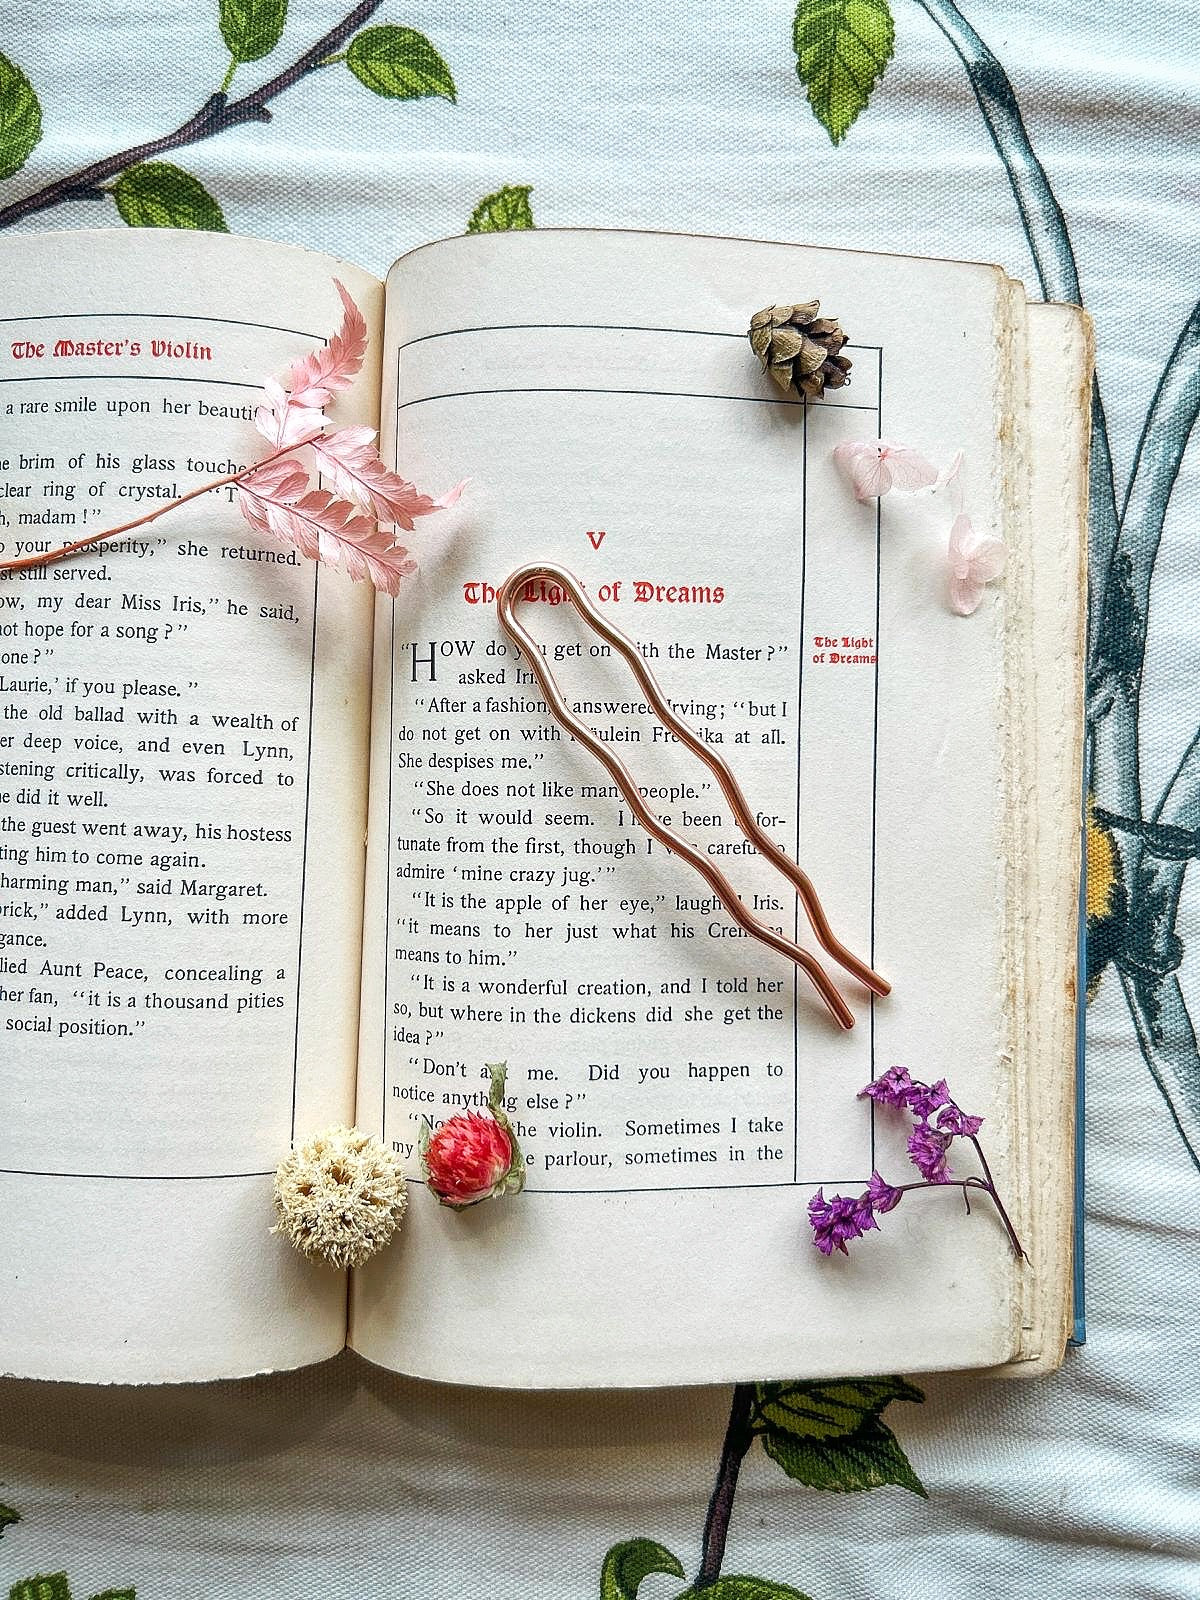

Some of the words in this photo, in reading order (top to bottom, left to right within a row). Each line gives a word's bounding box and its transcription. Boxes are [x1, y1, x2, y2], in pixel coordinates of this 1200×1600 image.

[11, 342, 45, 359] The
[151, 340, 212, 360] Violin
[20, 402, 48, 414] rare
[55, 397, 97, 413] smile
[107, 401, 150, 416] upon
[163, 398, 191, 414] her
[20, 454, 55, 469] brim
[68, 453, 86, 469] of
[96, 453, 120, 468] his
[132, 454, 175, 473] glass
[44, 481, 76, 501] ring
[89, 481, 106, 496] of
[119, 483, 181, 501] crystal.
[586, 532, 606, 550] V
[15, 541, 51, 557] your
[178, 541, 208, 557] she
[221, 545, 301, 566] returned.
[54, 565, 111, 580] served.
[598, 581, 622, 602] of
[633, 582, 724, 603] Dreams
[37, 596, 63, 613] my
[75, 593, 111, 608] dear
[121, 594, 161, 611] Miss
[227, 599, 248, 615] he
[260, 604, 299, 623] said,
[25, 621, 64, 641] hope
[70, 621, 94, 637] for
[486, 640, 507, 656] do
[554, 643, 582, 661] get
[590, 646, 611, 657] on
[668, 643, 695, 659] the
[813, 637, 838, 647] The
[841, 637, 873, 649] Light
[813, 653, 825, 663] of
[828, 653, 878, 664] Dreams
[459, 669, 506, 684] asked
[66, 677, 78, 693] if
[82, 682, 115, 697] you
[121, 679, 180, 699] please.
[4, 704, 27, 719] the
[39, 705, 62, 720] old
[75, 706, 124, 722] ballad
[137, 709, 178, 724] with
[212, 713, 273, 729] wealth
[281, 717, 299, 731] of
[399, 726, 414, 741] do
[423, 727, 447, 740] not
[455, 727, 481, 745] get
[489, 729, 510, 741] on
[520, 725, 560, 741] with
[735, 731, 750, 743] at
[761, 729, 785, 744] all.
[23, 733, 61, 753] deep
[74, 734, 122, 753] voice,
[138, 737, 170, 752] and
[182, 743, 225, 755] even
[243, 741, 293, 761] Lynn,
[399, 753, 422, 768] She
[429, 753, 494, 772] despises
[66, 762, 144, 784] critically,
[159, 770, 195, 782] was
[207, 768, 263, 784] forced
[277, 773, 294, 786] to
[17, 788, 41, 804] did
[48, 789, 59, 805] it
[67, 791, 108, 807] well.
[462, 781, 499, 796] does
[507, 783, 535, 797] not
[543, 781, 573, 797] like
[456, 809, 467, 824] it
[478, 809, 532, 825] would
[545, 814, 594, 825] seem.
[682, 811, 721, 826] been
[1, 816, 25, 831] the
[32, 820, 76, 837] guest
[82, 822, 127, 836] went
[134, 826, 187, 843] away,
[196, 823, 221, 839] his
[227, 824, 291, 842] hostess
[398, 836, 440, 851] tunate
[446, 837, 484, 852] from
[491, 837, 518, 853] the
[525, 837, 564, 856] first,
[572, 838, 635, 859] though
[36, 846, 66, 862] him
[72, 850, 89, 863] to
[97, 853, 143, 865] come
[150, 852, 205, 871] again.
[397, 863, 444, 879] admire
[510, 870, 555, 886] crazy
[137, 879, 172, 895] said
[180, 880, 267, 901] Margaret.
[442, 892, 454, 908] is
[460, 893, 486, 909] the
[496, 895, 541, 914] apple
[552, 895, 570, 910] of
[580, 895, 608, 911] her
[753, 895, 783, 910] Iris.
[56, 904, 108, 921] added
[121, 906, 172, 927] Lynn,
[187, 909, 229, 924] with
[243, 913, 288, 925] more
[430, 924, 480, 937] means
[494, 924, 511, 938] to
[525, 923, 553, 938] her
[565, 923, 598, 943] just
[612, 923, 657, 939] what
[671, 923, 694, 938] his
[396, 949, 439, 963] means
[445, 950, 461, 964] to
[40, 960, 82, 977] Aunt
[94, 962, 148, 982] Peace,
[165, 965, 263, 985] concealing
[442, 974, 455, 993] is
[478, 979, 567, 995] wonderful
[578, 979, 651, 997] creation,
[661, 978, 691, 994] and
[716, 977, 748, 993] told
[757, 978, 783, 992] her
[29, 988, 57, 1007] fan,
[145, 993, 228, 1009] thousand
[237, 993, 284, 1013] pities
[394, 1003, 411, 1018] so,
[419, 1002, 443, 1019] but
[450, 1005, 502, 1022] where
[510, 1007, 526, 1024] in
[533, 1008, 561, 1024] the
[570, 1007, 636, 1023] dickens
[646, 1006, 672, 1022] did
[685, 1006, 713, 1021] she
[724, 1006, 751, 1025] get
[757, 1005, 783, 1020] the
[6, 1017, 51, 1032] social
[528, 1069, 558, 1080] me.
[589, 1064, 619, 1081] Did
[638, 1067, 670, 1084] you
[688, 1062, 750, 1082] happen
[766, 1062, 783, 1076] to
[393, 1085, 434, 1102] notice
[548, 1122, 601, 1138] violin.
[625, 1119, 720, 1136] Sometimes
[748, 1117, 783, 1133] take
[393, 1141, 413, 1159] my
[545, 1151, 612, 1170] parlour,
[625, 1147, 717, 1165] sometimes
[729, 1146, 744, 1161] in
[757, 1145, 783, 1160] the
